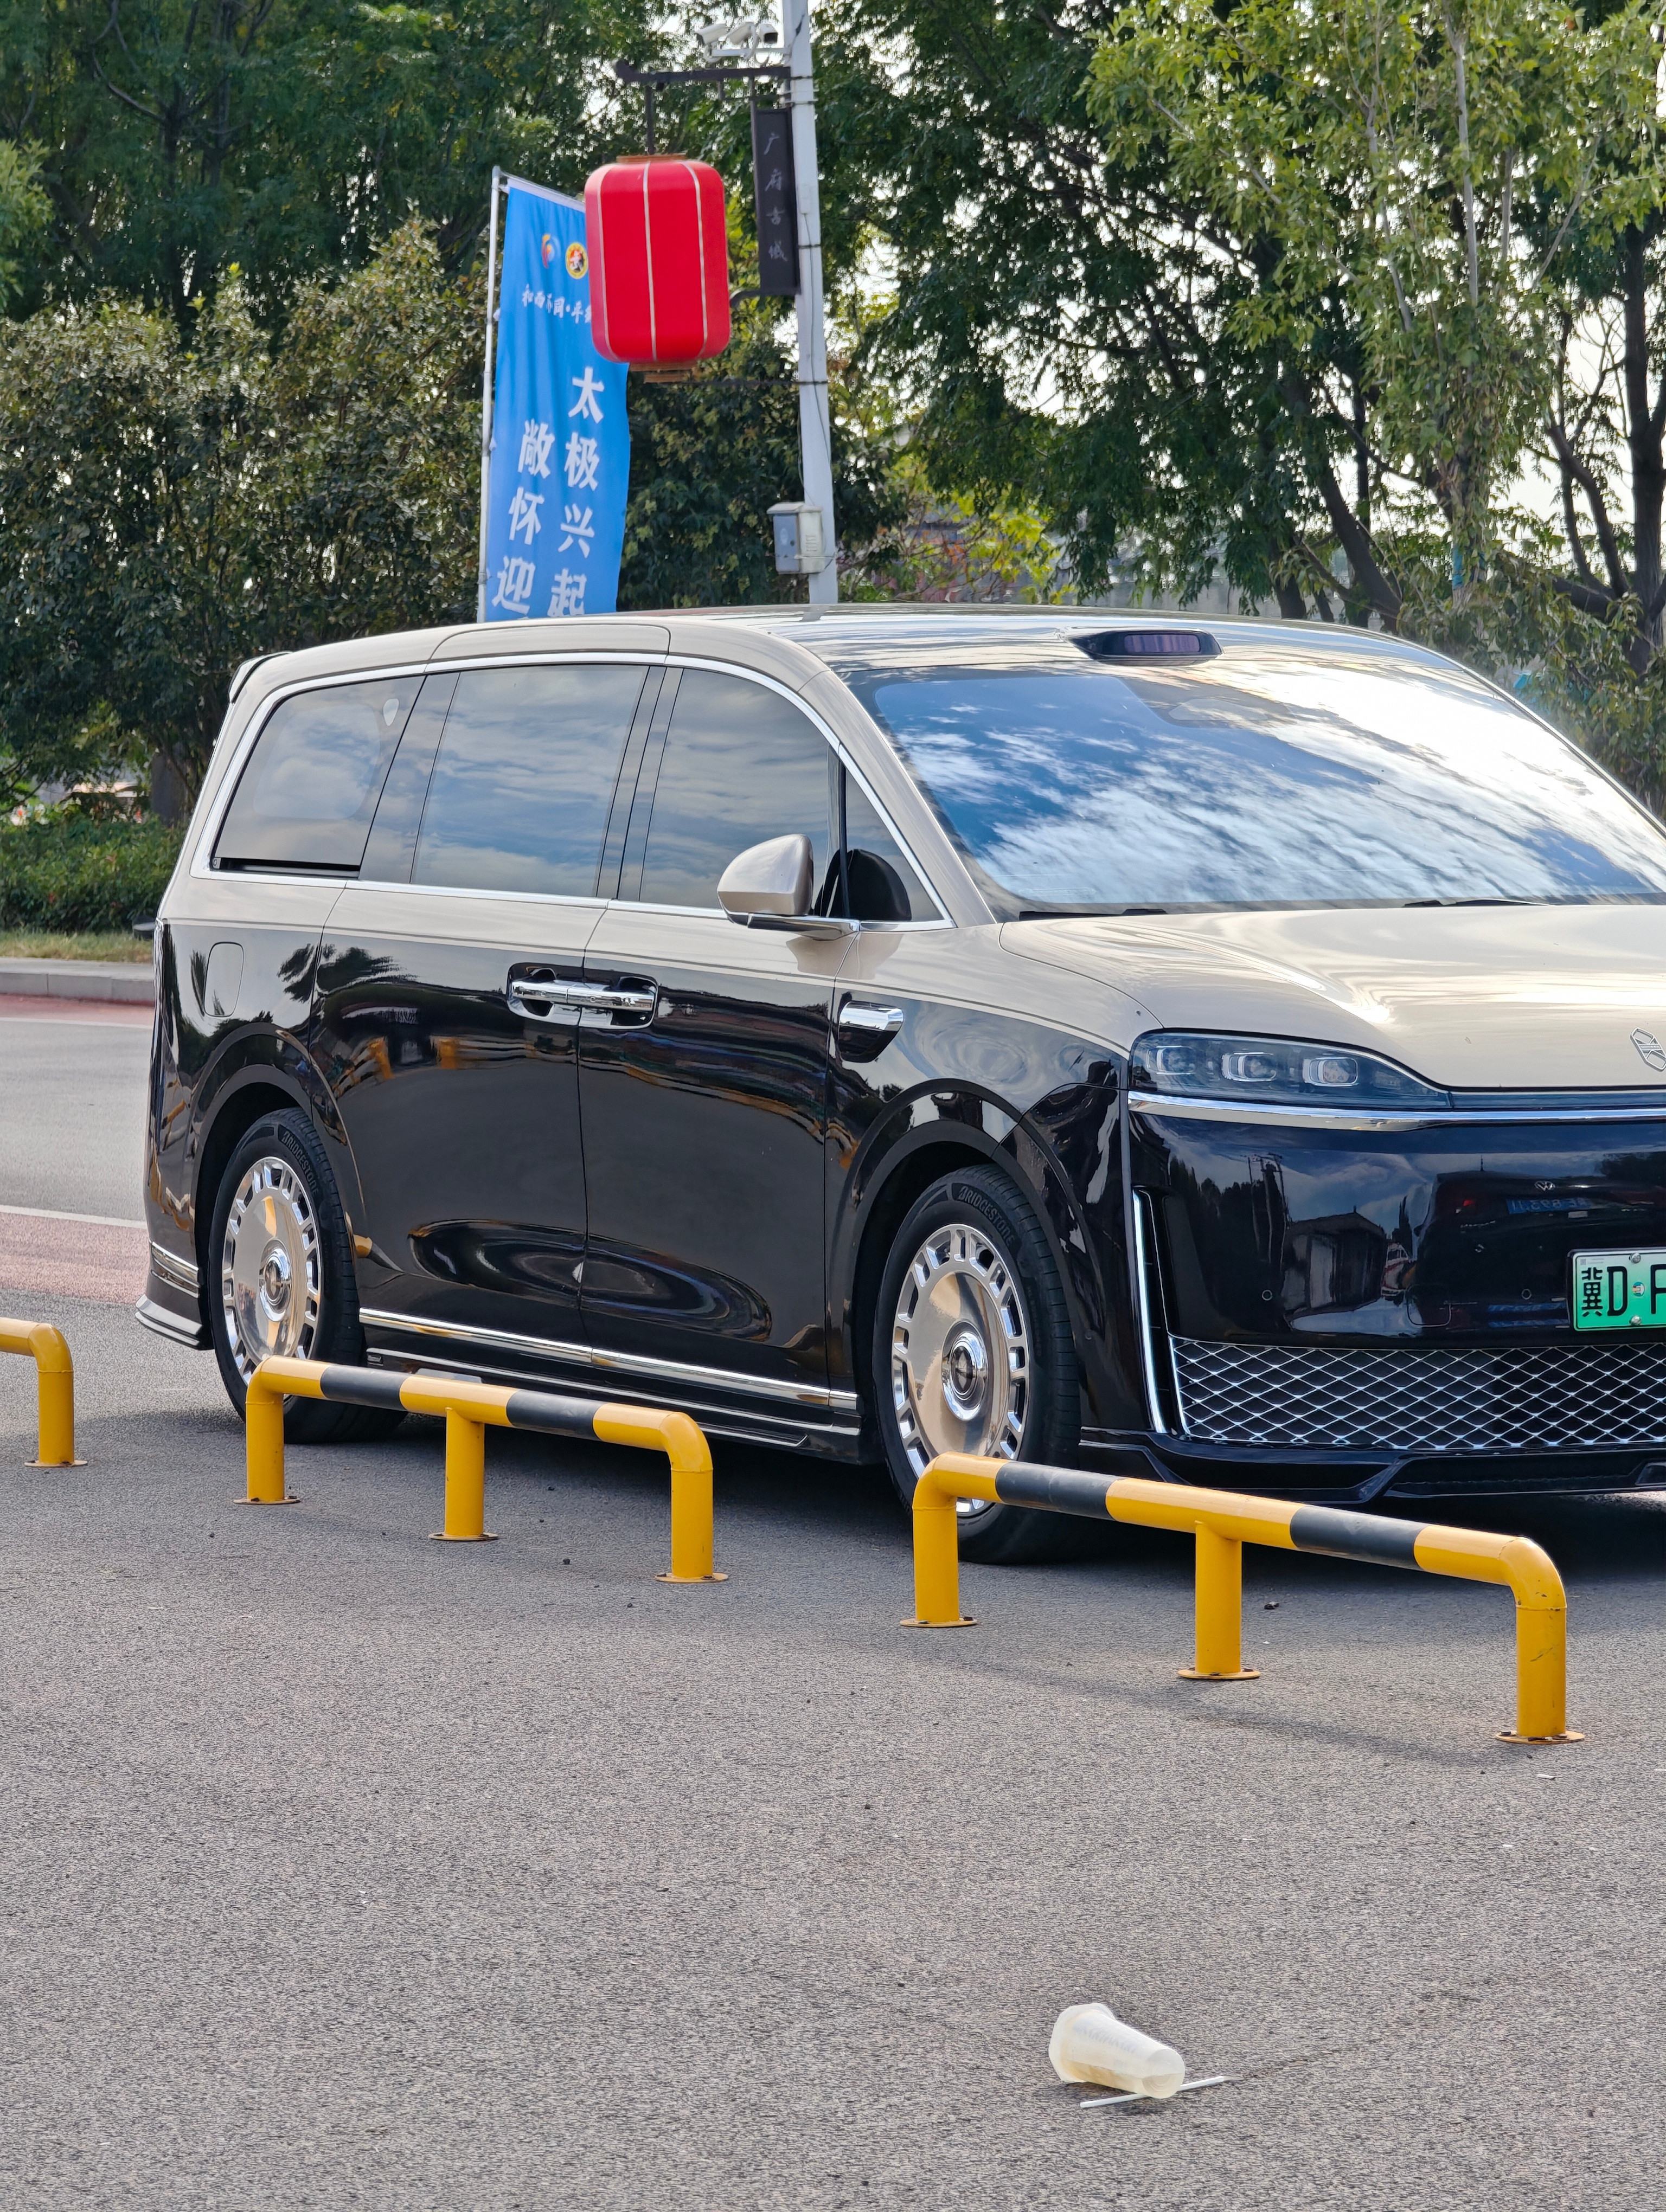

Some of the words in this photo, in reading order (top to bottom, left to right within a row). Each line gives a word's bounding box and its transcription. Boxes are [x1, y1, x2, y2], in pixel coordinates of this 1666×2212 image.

[547, 366, 605, 617] 太极兴起
[281, 1131, 319, 1197] BRIDGESTONE
[958, 1186, 1015, 1245] BRIDGESTONE
